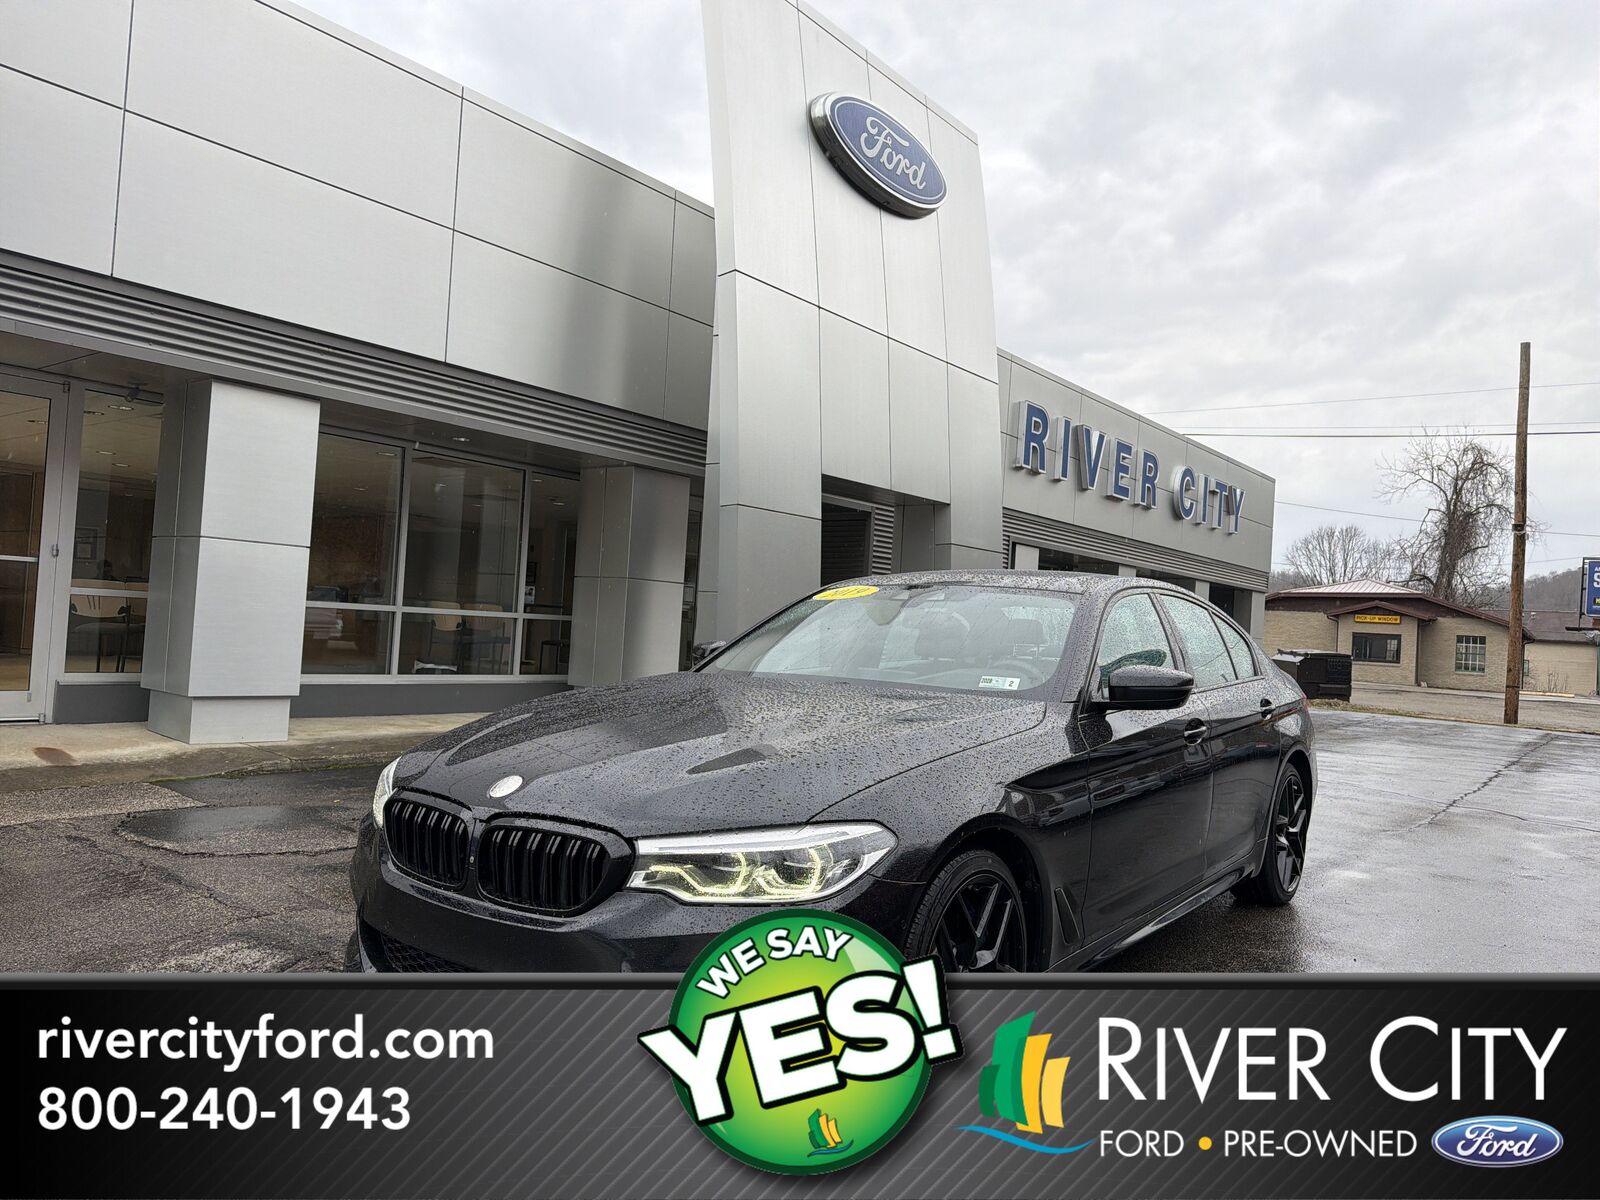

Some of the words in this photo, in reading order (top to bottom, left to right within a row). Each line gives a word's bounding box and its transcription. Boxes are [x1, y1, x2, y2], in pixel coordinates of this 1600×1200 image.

[860, 116, 927, 190] Ford
[1016, 400, 1160, 509] RIVER
[1173, 465, 1246, 534] CITY
